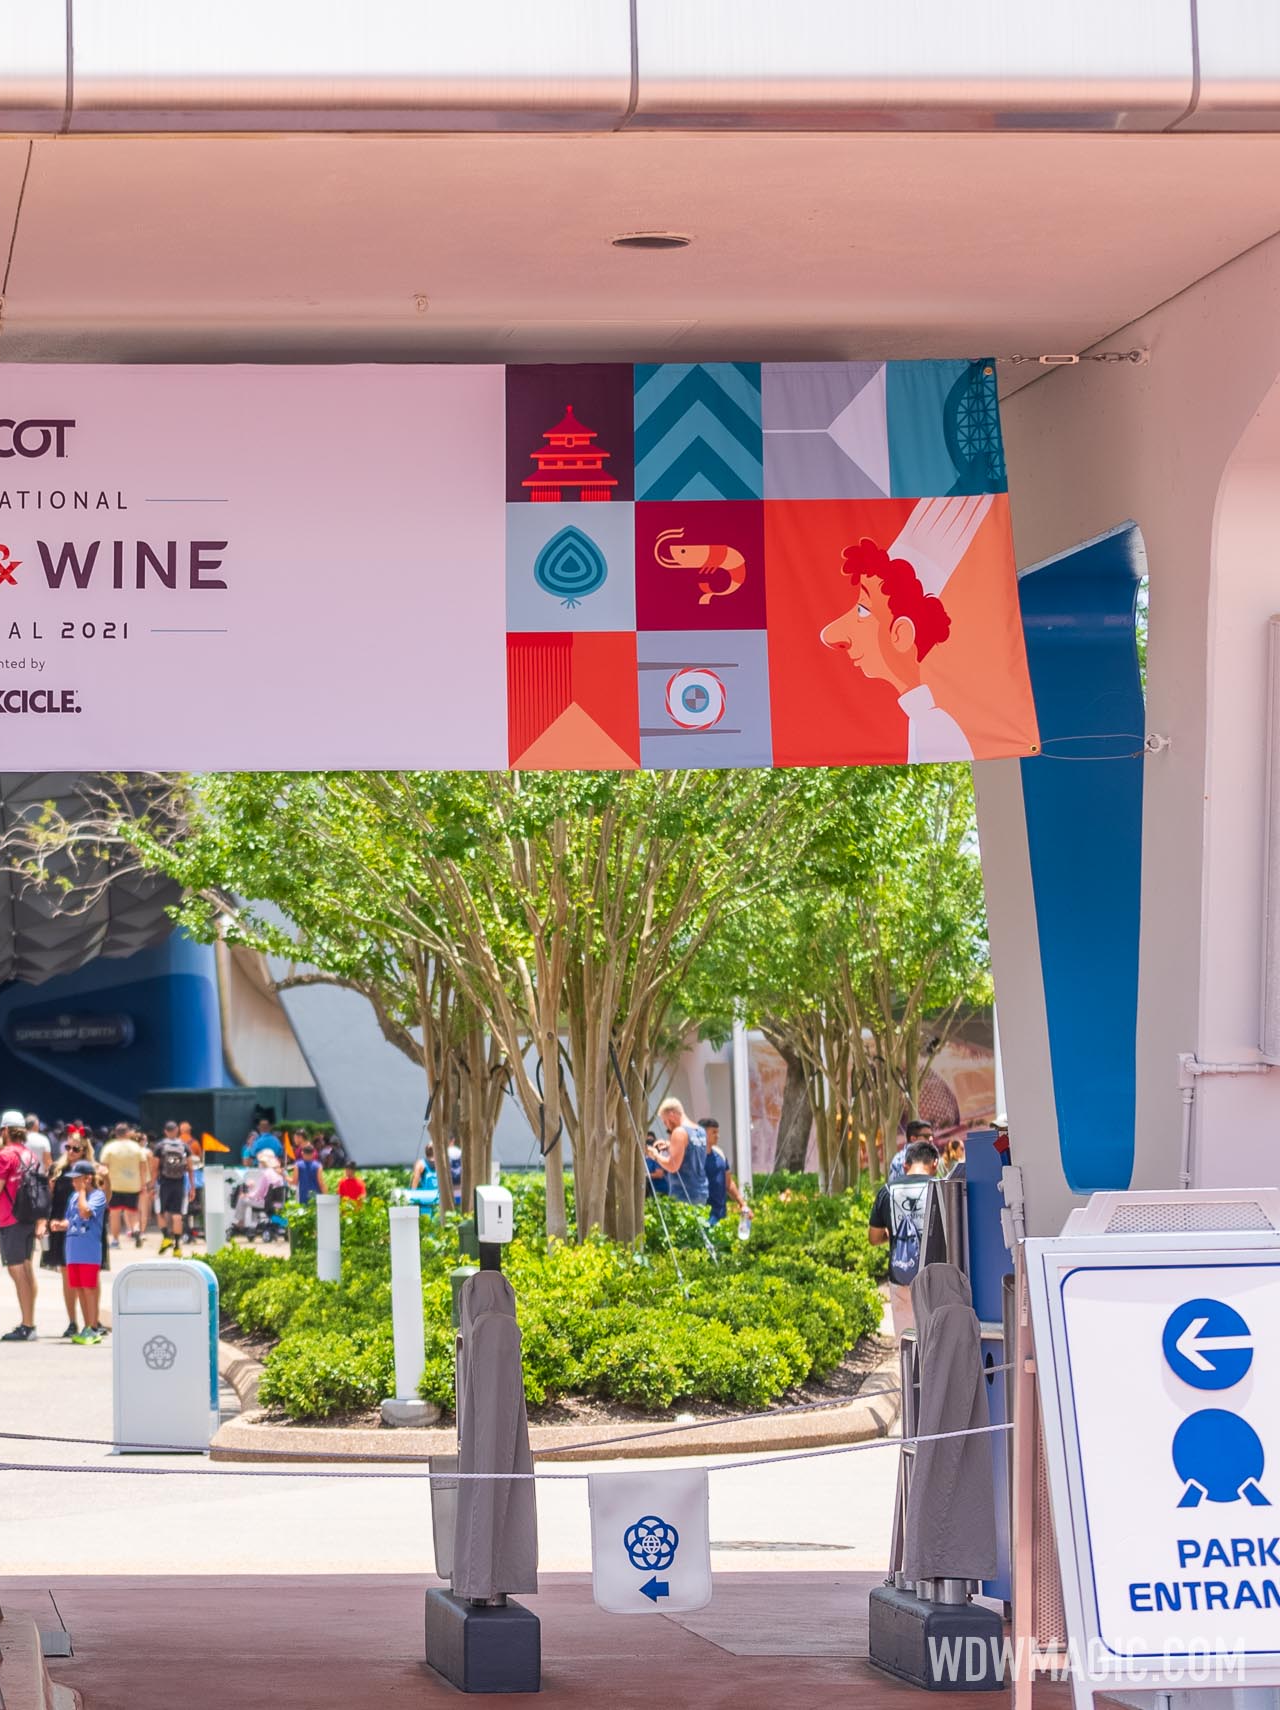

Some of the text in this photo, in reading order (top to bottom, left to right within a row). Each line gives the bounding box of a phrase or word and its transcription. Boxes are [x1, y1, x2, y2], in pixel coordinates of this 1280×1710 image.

[35, 539, 230, 590] WINE
[60, 621, 128, 640] 2021
[30, 657, 47, 673] by
[1176, 1537, 1280, 1569] PARK
[1128, 1579, 1280, 1612] ENTRAN
